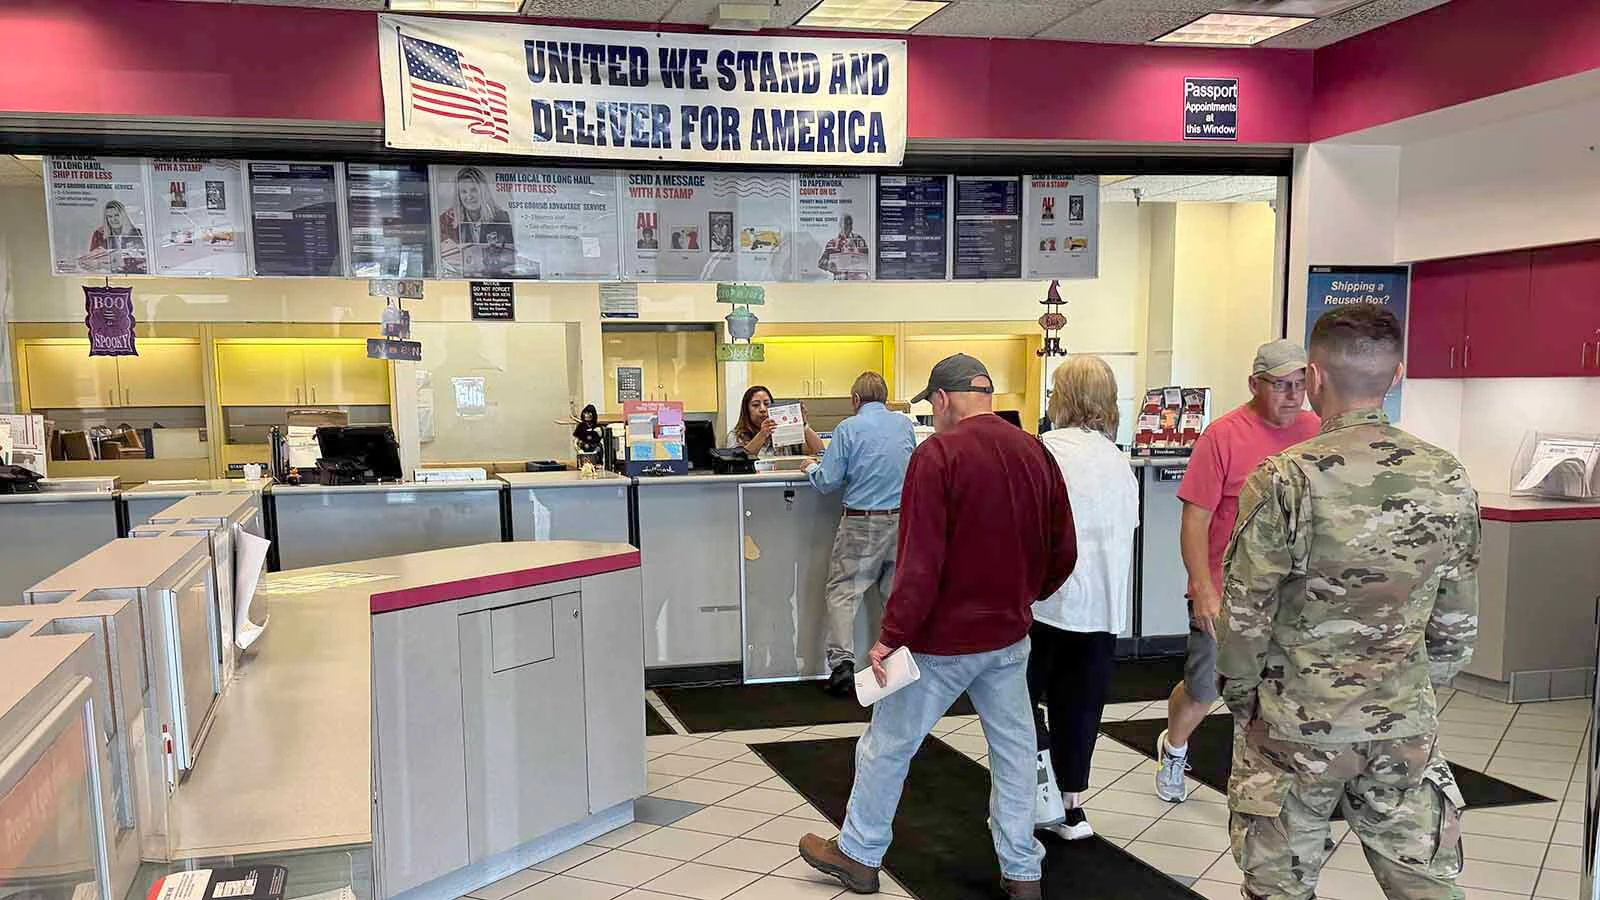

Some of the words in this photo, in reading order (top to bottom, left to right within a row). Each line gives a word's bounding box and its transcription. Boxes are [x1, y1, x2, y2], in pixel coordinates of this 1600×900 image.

[523, 39, 649, 89] UNITED
[659, 48, 709, 91] WE
[716, 49, 823, 95] STAND
[828, 52, 890, 96] AND
[1185, 82, 1237, 100] Passport
[1185, 101, 1237, 113] Appointments
[1205, 113, 1214, 122] at
[530, 98, 671, 149] DELIVER
[680, 103, 741, 152] FOR
[750, 106, 887, 154] AMERICA
[1186, 124, 1201, 134] this
[1202, 124, 1236, 134] Window
[52, 161, 62, 170] TO
[63, 161, 83, 170] LONG
[154, 163, 172, 172] WITH
[172, 164, 178, 172] A
[179, 164, 203, 172] STAMP
[52, 170, 70, 179] SHIP
[71, 171, 78, 179] IT
[80, 171, 94, 180] FOR
[95, 171, 113, 180] LESS
[496, 173, 517, 182] FROM
[518, 174, 541, 183] LOCAL
[542, 174, 552, 183] TO
[553, 175, 572, 184] LONG
[629, 174, 654, 185] SEND
[655, 175, 662, 185] A
[663, 175, 705, 186] MESSAGE
[496, 183, 514, 193] SHIP
[514, 183, 522, 193] IT
[523, 184, 538, 193] FOR
[539, 184, 557, 194] LESS
[629, 187, 653, 198] WITH
[655, 188, 661, 198] A
[663, 188, 694, 200] STAMP
[1331, 281, 1376, 293] Shipping
[94, 296, 125, 310] BOO
[1324, 295, 1363, 305] Reused
[1365, 295, 1390, 305] Box?
[95, 333, 129, 349] SPOOKY
